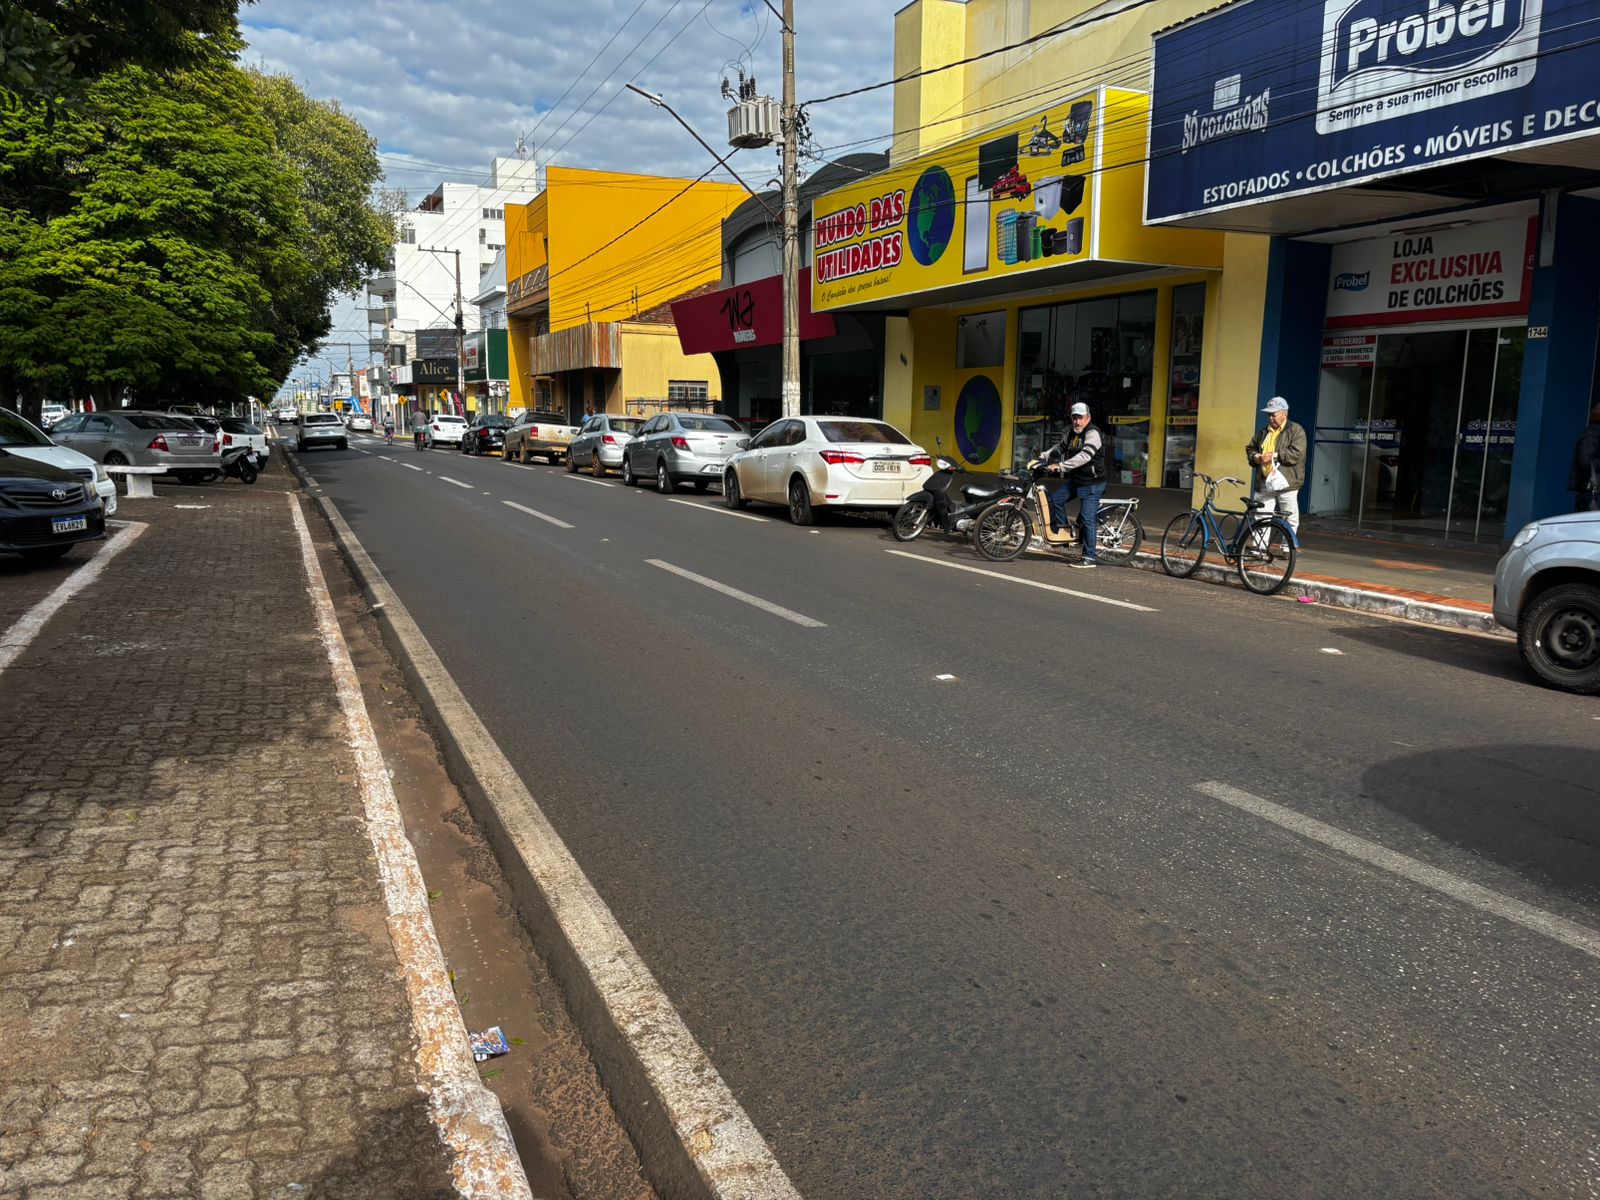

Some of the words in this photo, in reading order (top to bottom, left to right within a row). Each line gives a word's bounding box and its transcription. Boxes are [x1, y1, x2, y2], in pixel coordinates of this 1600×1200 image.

[1328, 102, 1373, 122] Sempre
[1376, 101, 1384, 111] a
[1387, 93, 1409, 109] sua
[1412, 81, 1461, 103] melhor
[1464, 65, 1518, 89] escolha
[1182, 109, 1198, 154] SÓ
[1200, 87, 1270, 141] COLCHÕES
[1203, 170, 1290, 204] ESTOFADOS
[1306, 144, 1406, 181] COLCHÕES
[1424, 120, 1513, 157] MÓVEIS
[1522, 114, 1536, 136] E
[815, 203, 866, 249] MUNDO
[870, 189, 905, 233] DAS
[816, 231, 903, 284] UTILIDADES
[1393, 236, 1434, 259] LOJA
[1336, 272, 1367, 288] Probel
[1390, 251, 1503, 285] EXCLUSIVA
[847, 283, 856, 293] dos
[1388, 289, 1409, 308] DE
[1413, 278, 1505, 306] COLCHÕES
[1333, 336, 1366, 345] VENDEMOS
[1528, 327, 1547, 337] 1744
[419, 362, 450, 375] Alice
